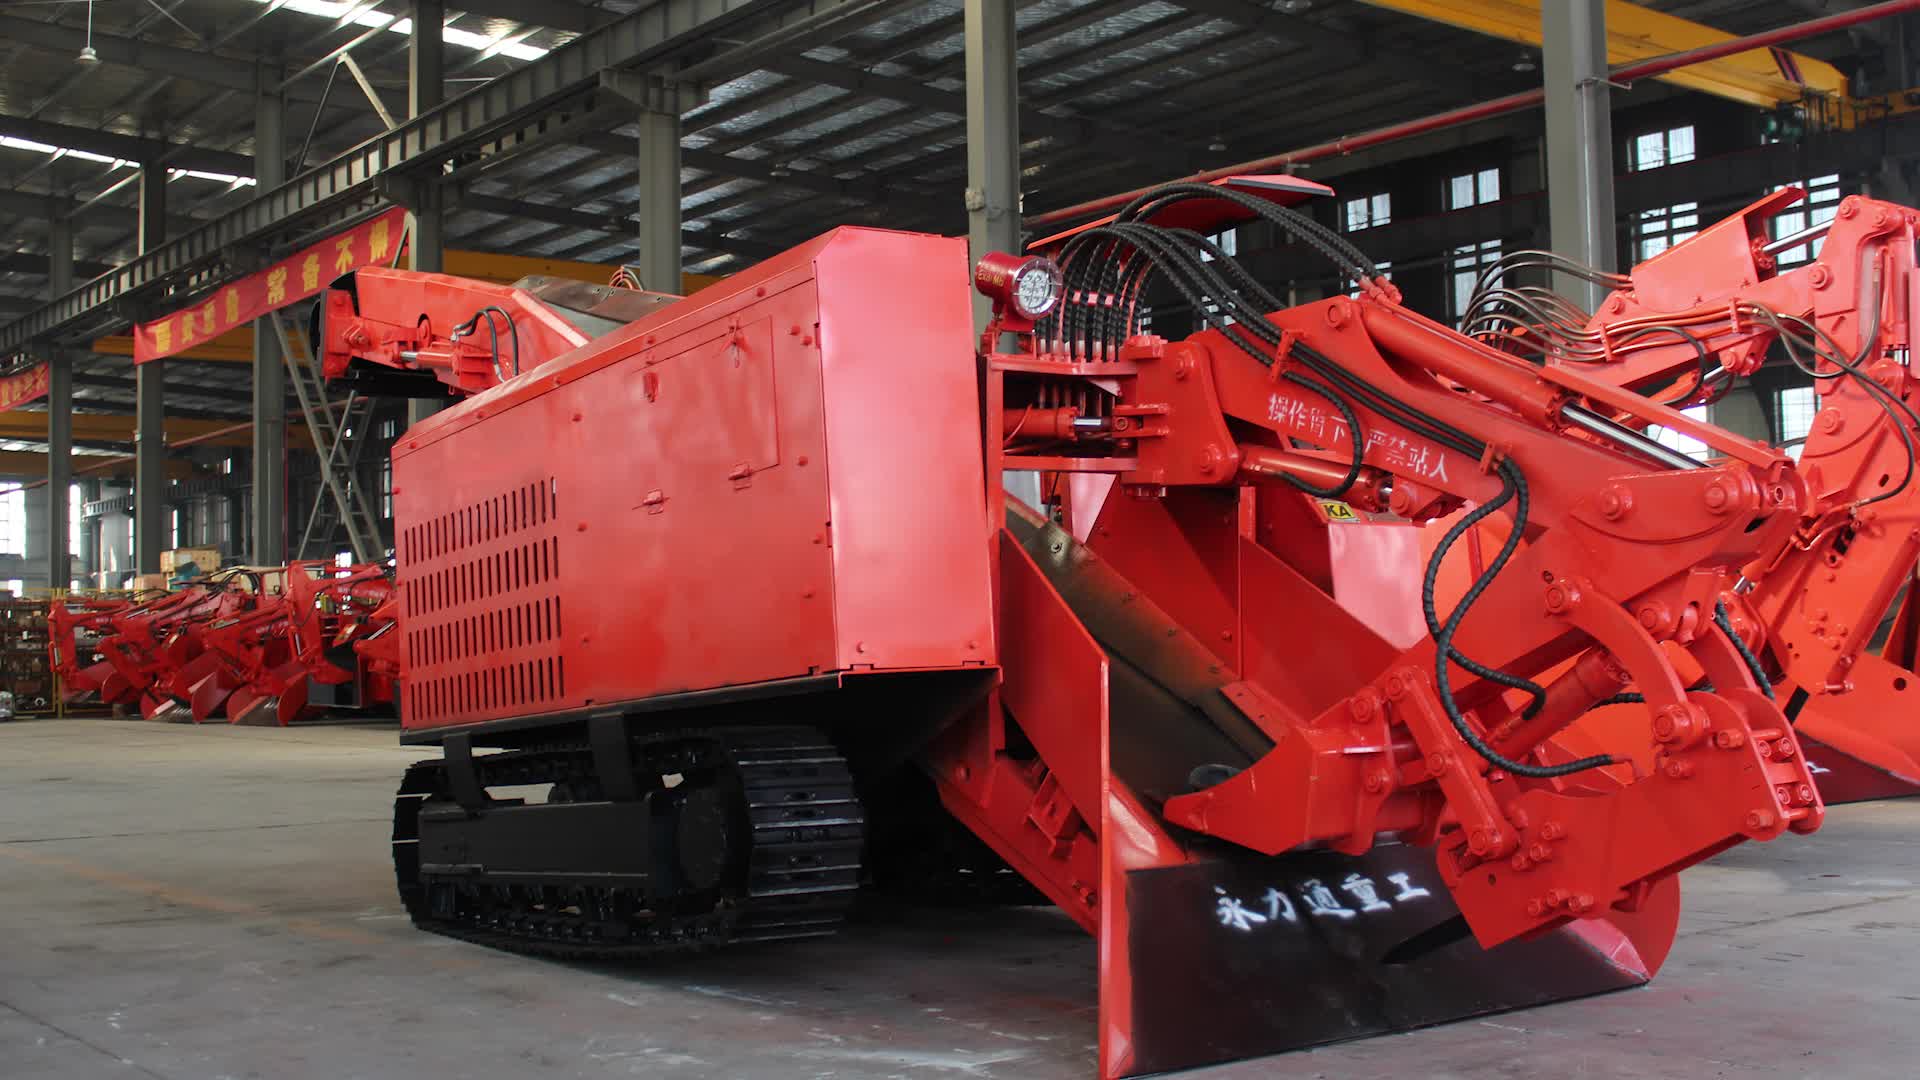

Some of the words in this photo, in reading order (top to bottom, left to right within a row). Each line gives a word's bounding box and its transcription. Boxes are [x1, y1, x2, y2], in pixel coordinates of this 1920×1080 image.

[1364, 428, 1449, 483] 严禁站人
[1323, 504, 1352, 517] KA
[1214, 872, 1431, 931] 永力通重工
